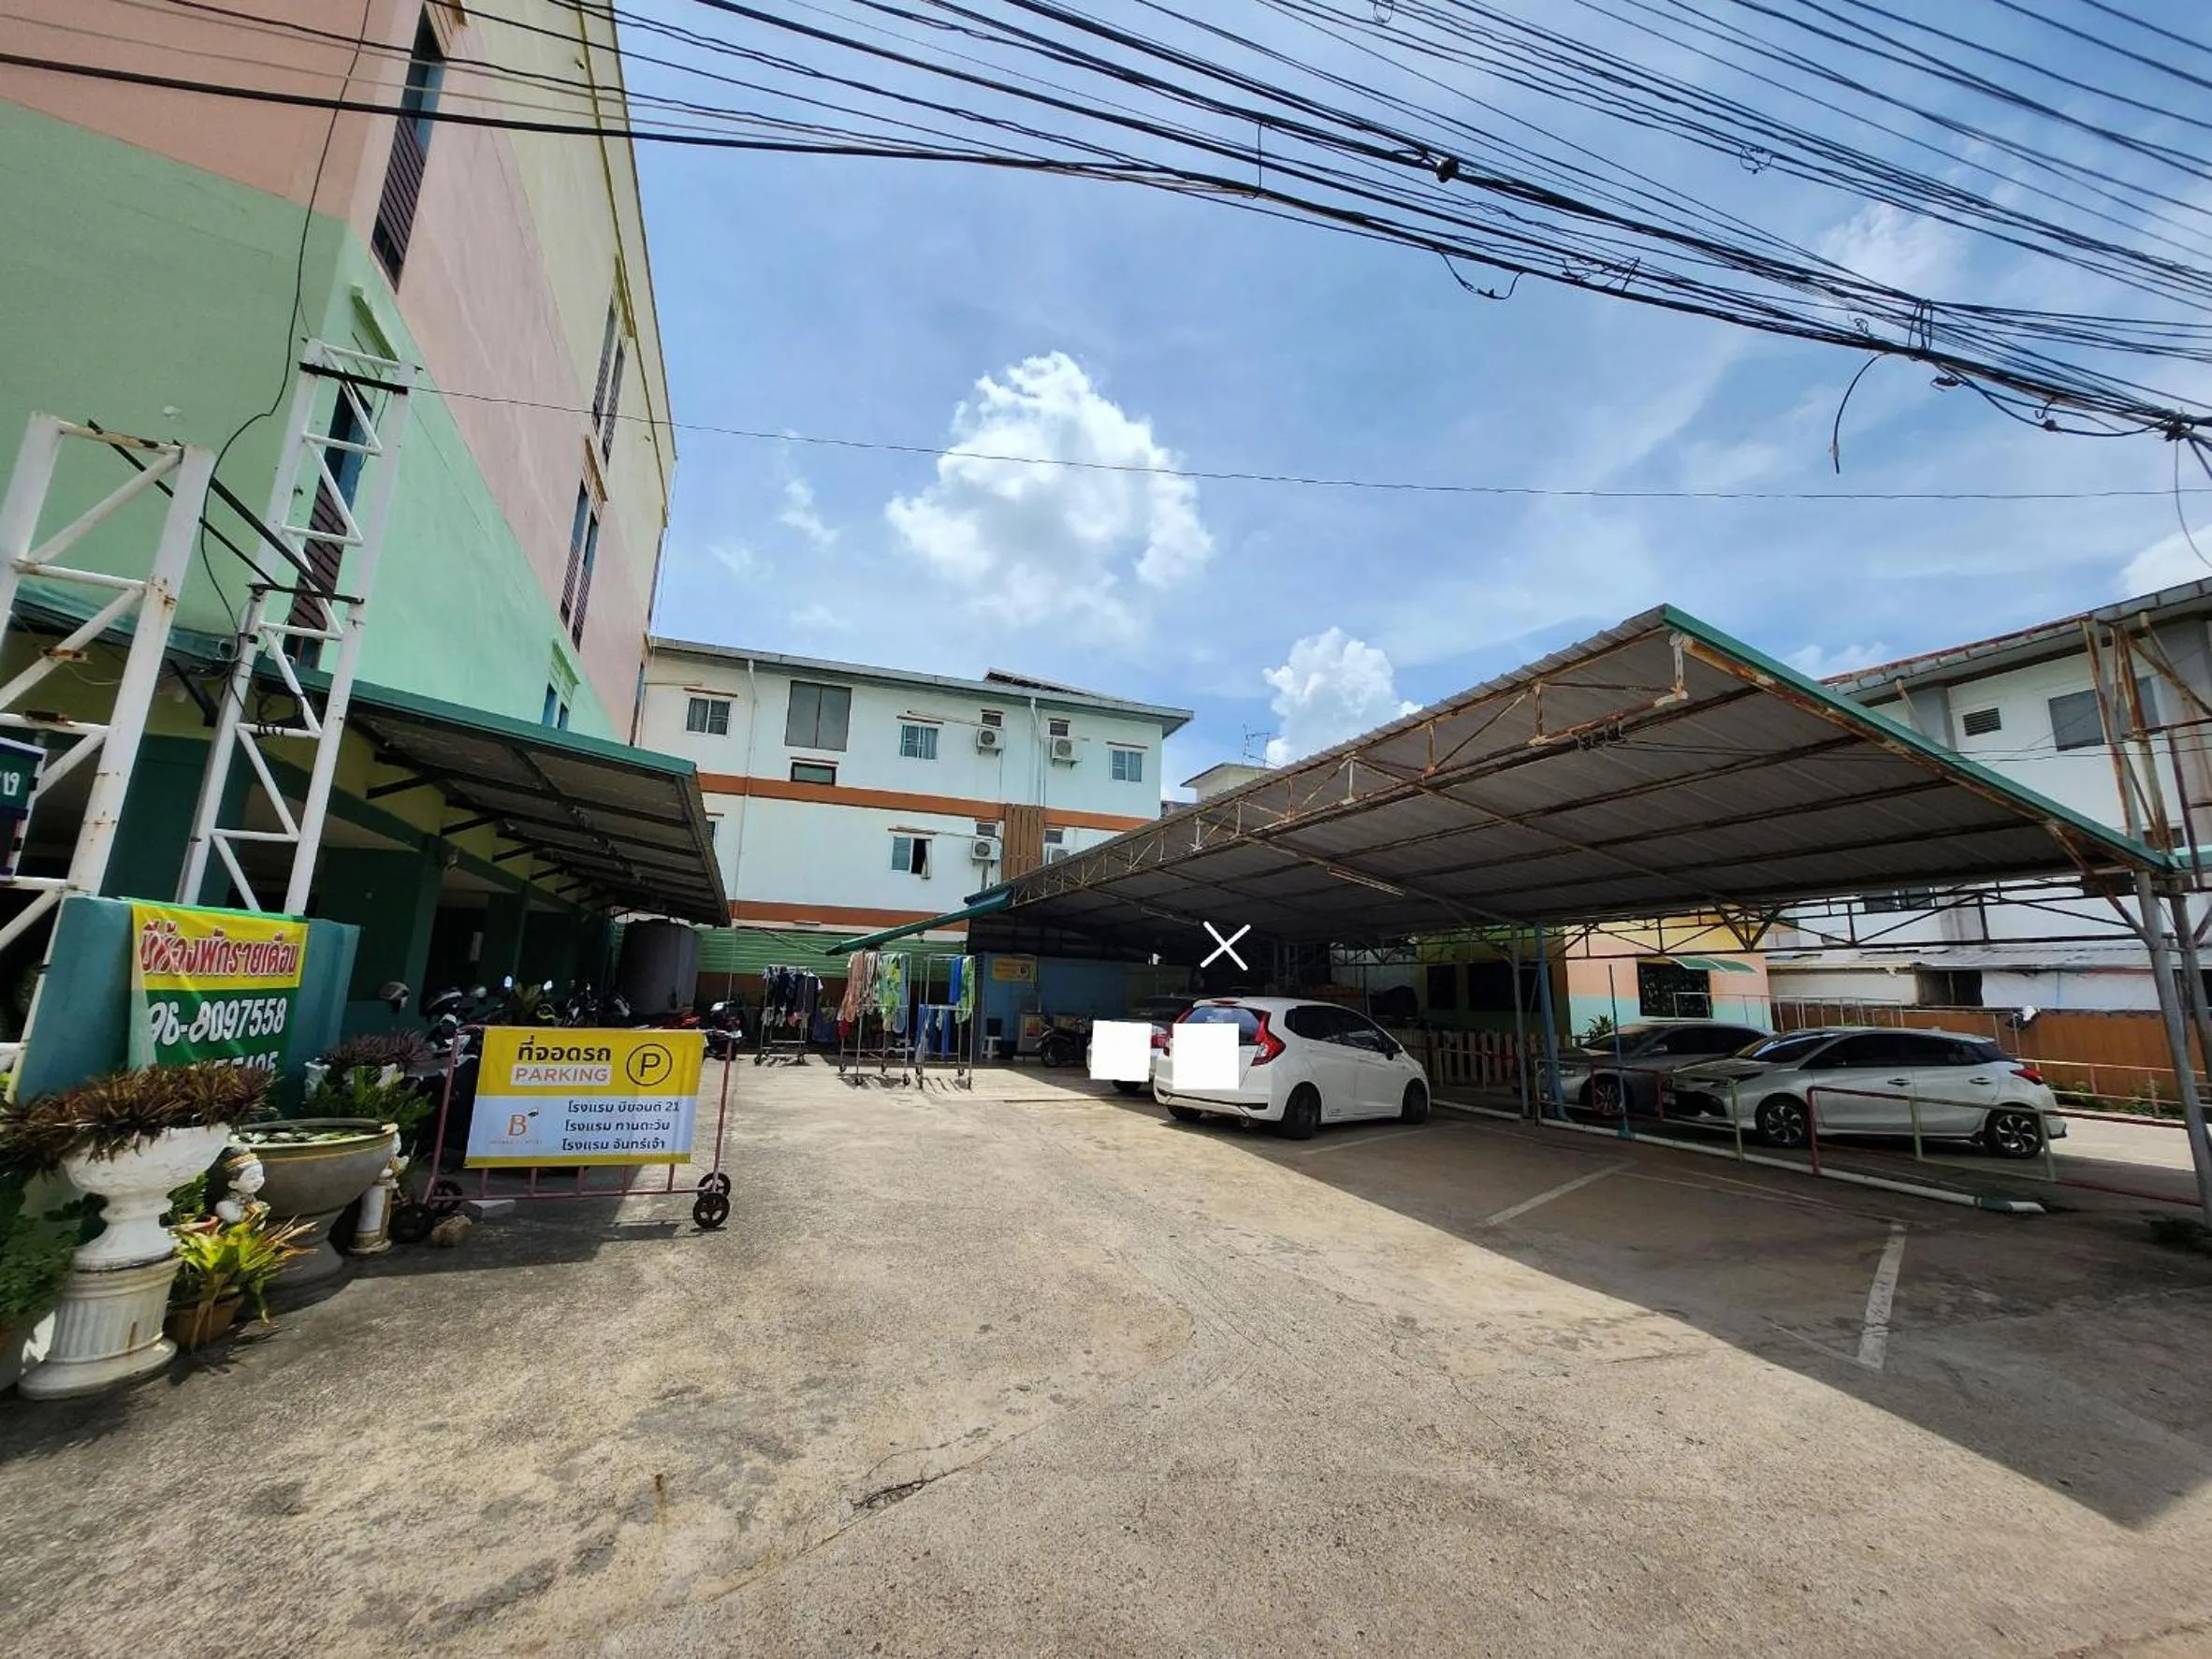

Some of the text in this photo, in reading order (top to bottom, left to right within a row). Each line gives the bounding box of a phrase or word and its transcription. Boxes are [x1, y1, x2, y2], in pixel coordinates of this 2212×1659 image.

[517, 1034, 612, 1062] ที่จอดรถ
[515, 1068, 608, 1083] PARKING
[567, 1099, 615, 1113] โรงแรม
[665, 1100, 680, 1113] 21
[508, 1113, 528, 1136] B
[564, 1118, 671, 1132] โรงแรม ทานตะวัน
[561, 1137, 609, 1151] โรงแรม
